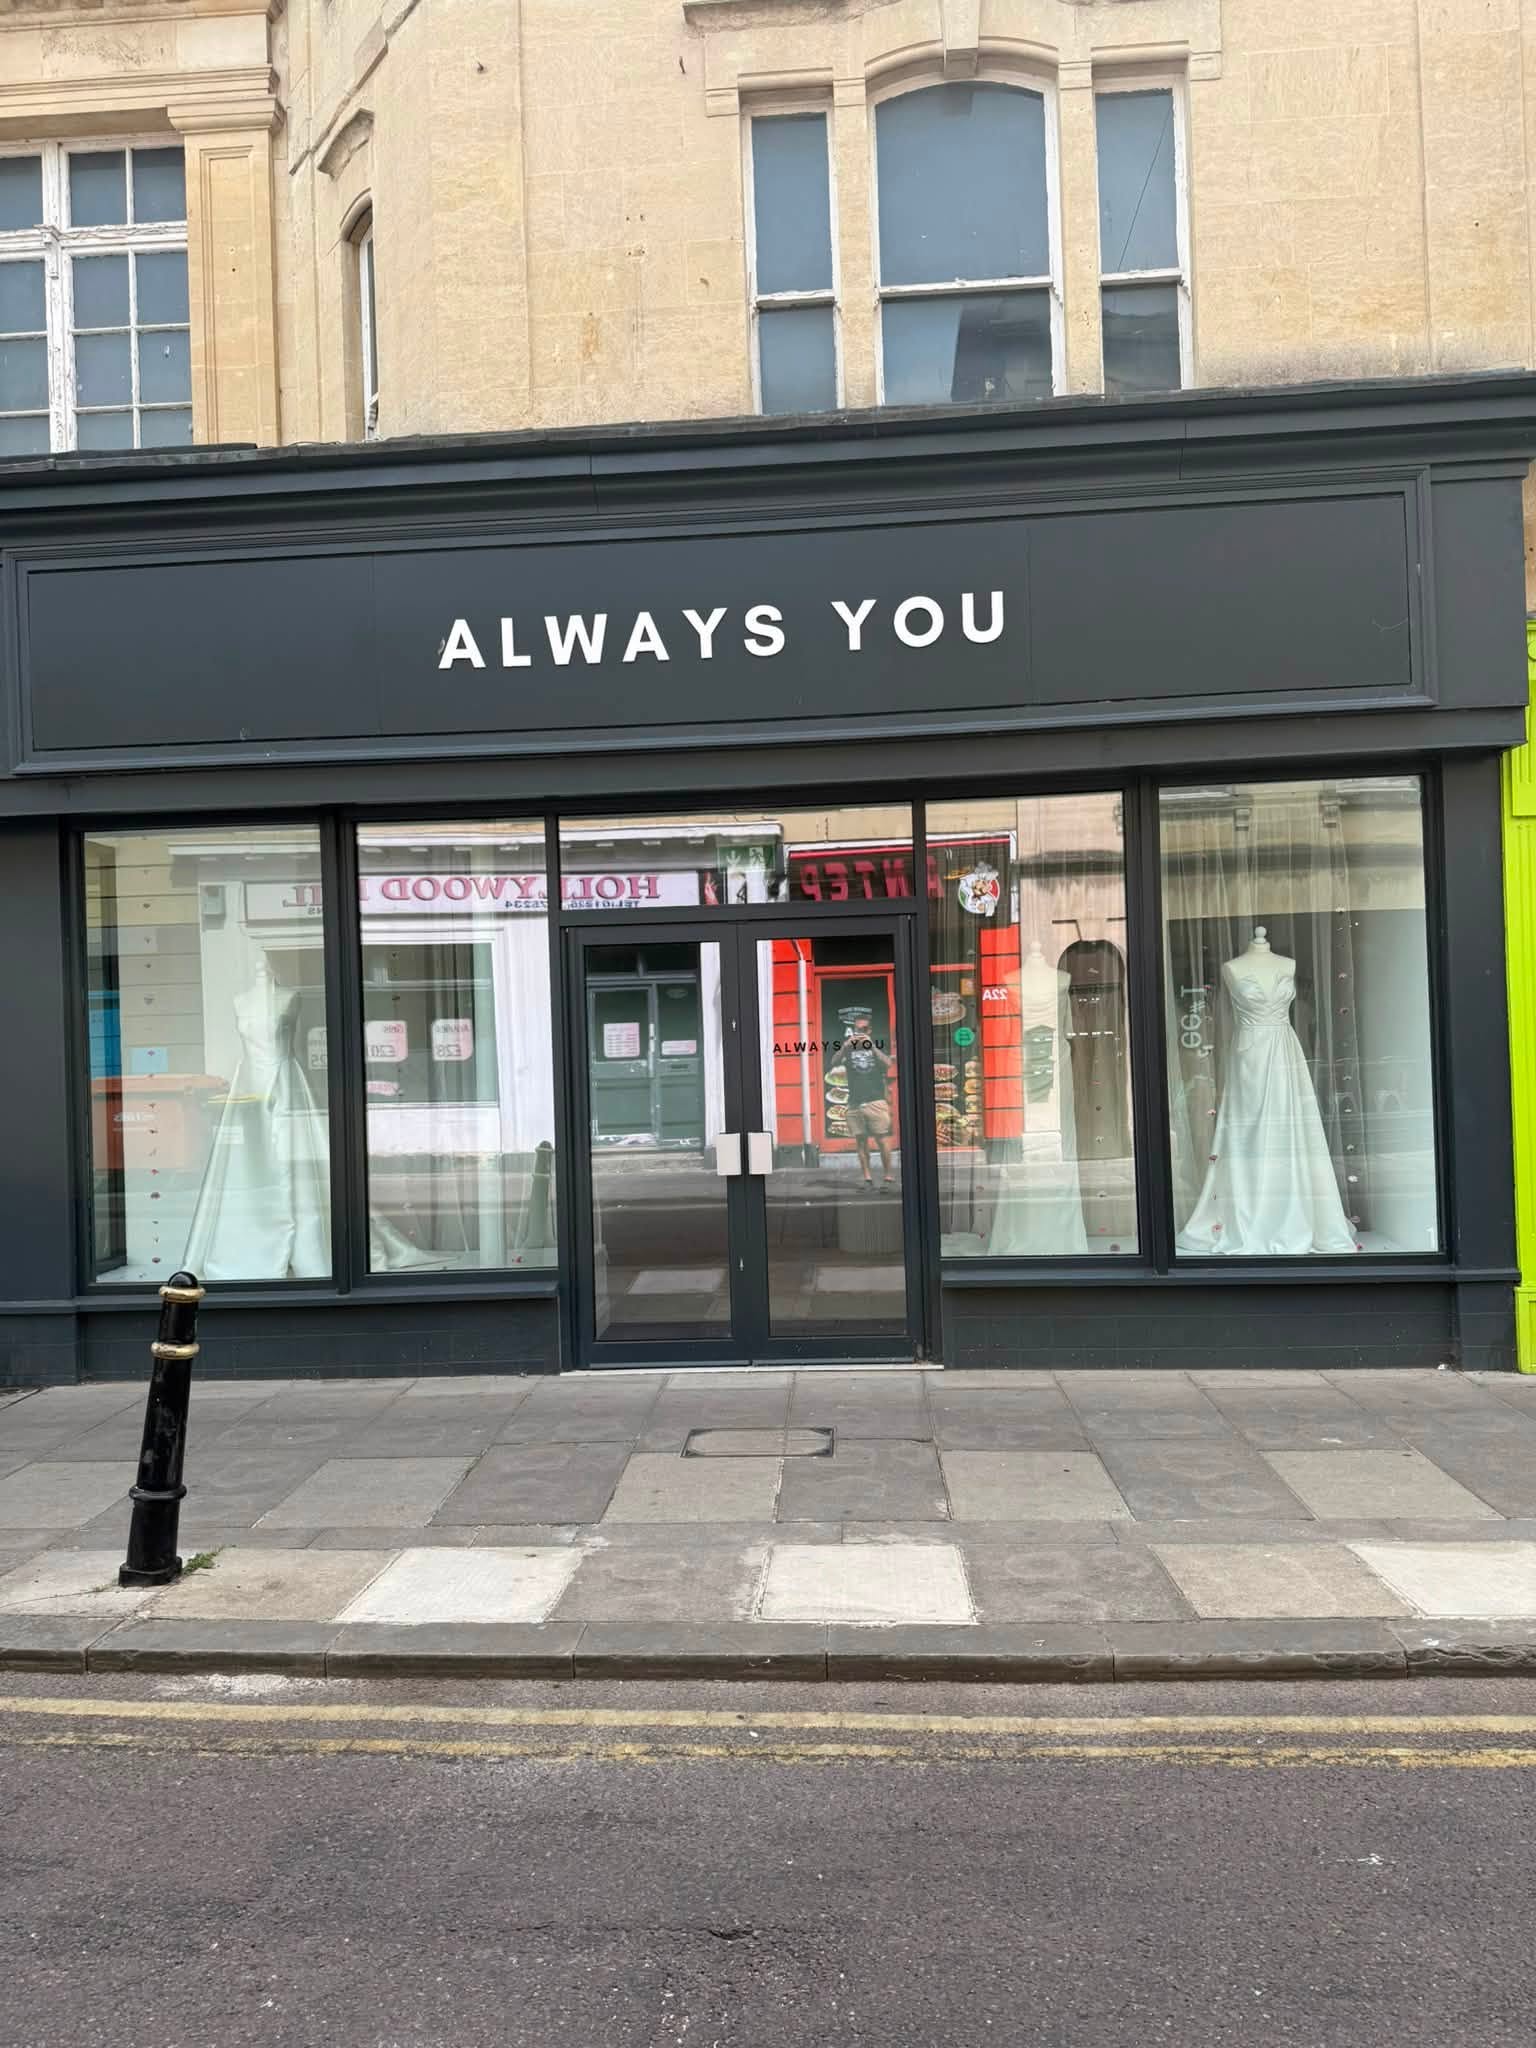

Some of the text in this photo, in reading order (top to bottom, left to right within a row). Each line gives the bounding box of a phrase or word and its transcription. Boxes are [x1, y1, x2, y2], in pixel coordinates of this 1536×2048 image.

[438, 590, 1005, 670] ALWAYS YOU
[773, 1039, 884, 1053] ALWAYS YOU
